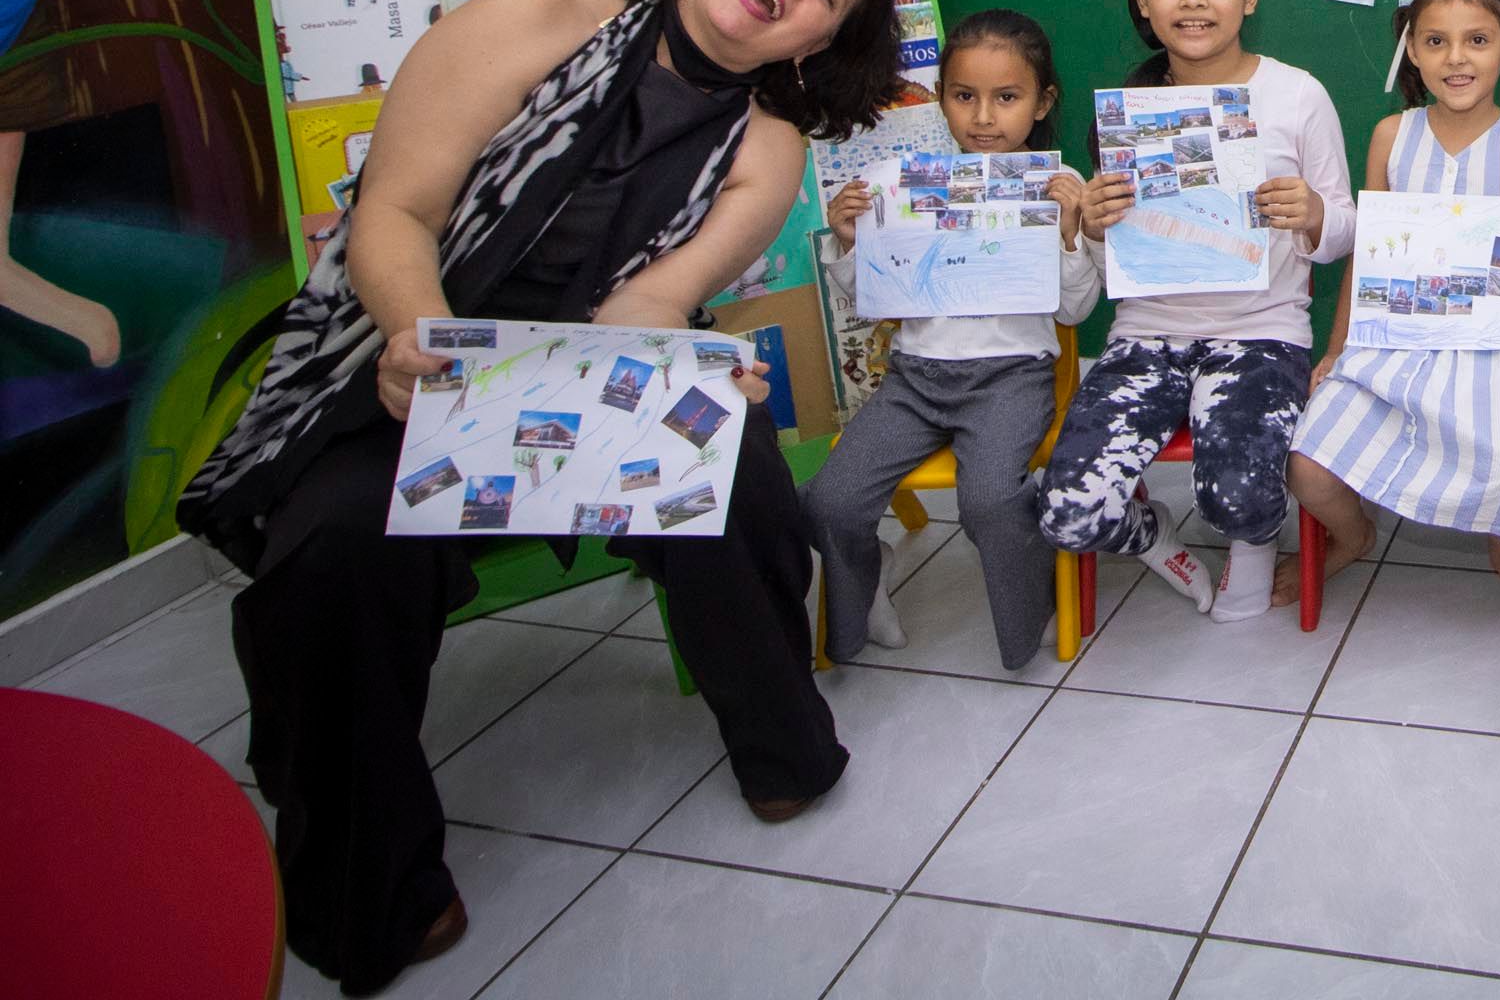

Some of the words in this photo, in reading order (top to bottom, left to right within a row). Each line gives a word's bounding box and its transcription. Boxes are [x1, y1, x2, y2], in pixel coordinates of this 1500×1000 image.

[301, 20, 326, 31] César
[327, 18, 358, 29] Vallejo
[388, 1, 404, 39] Masa
